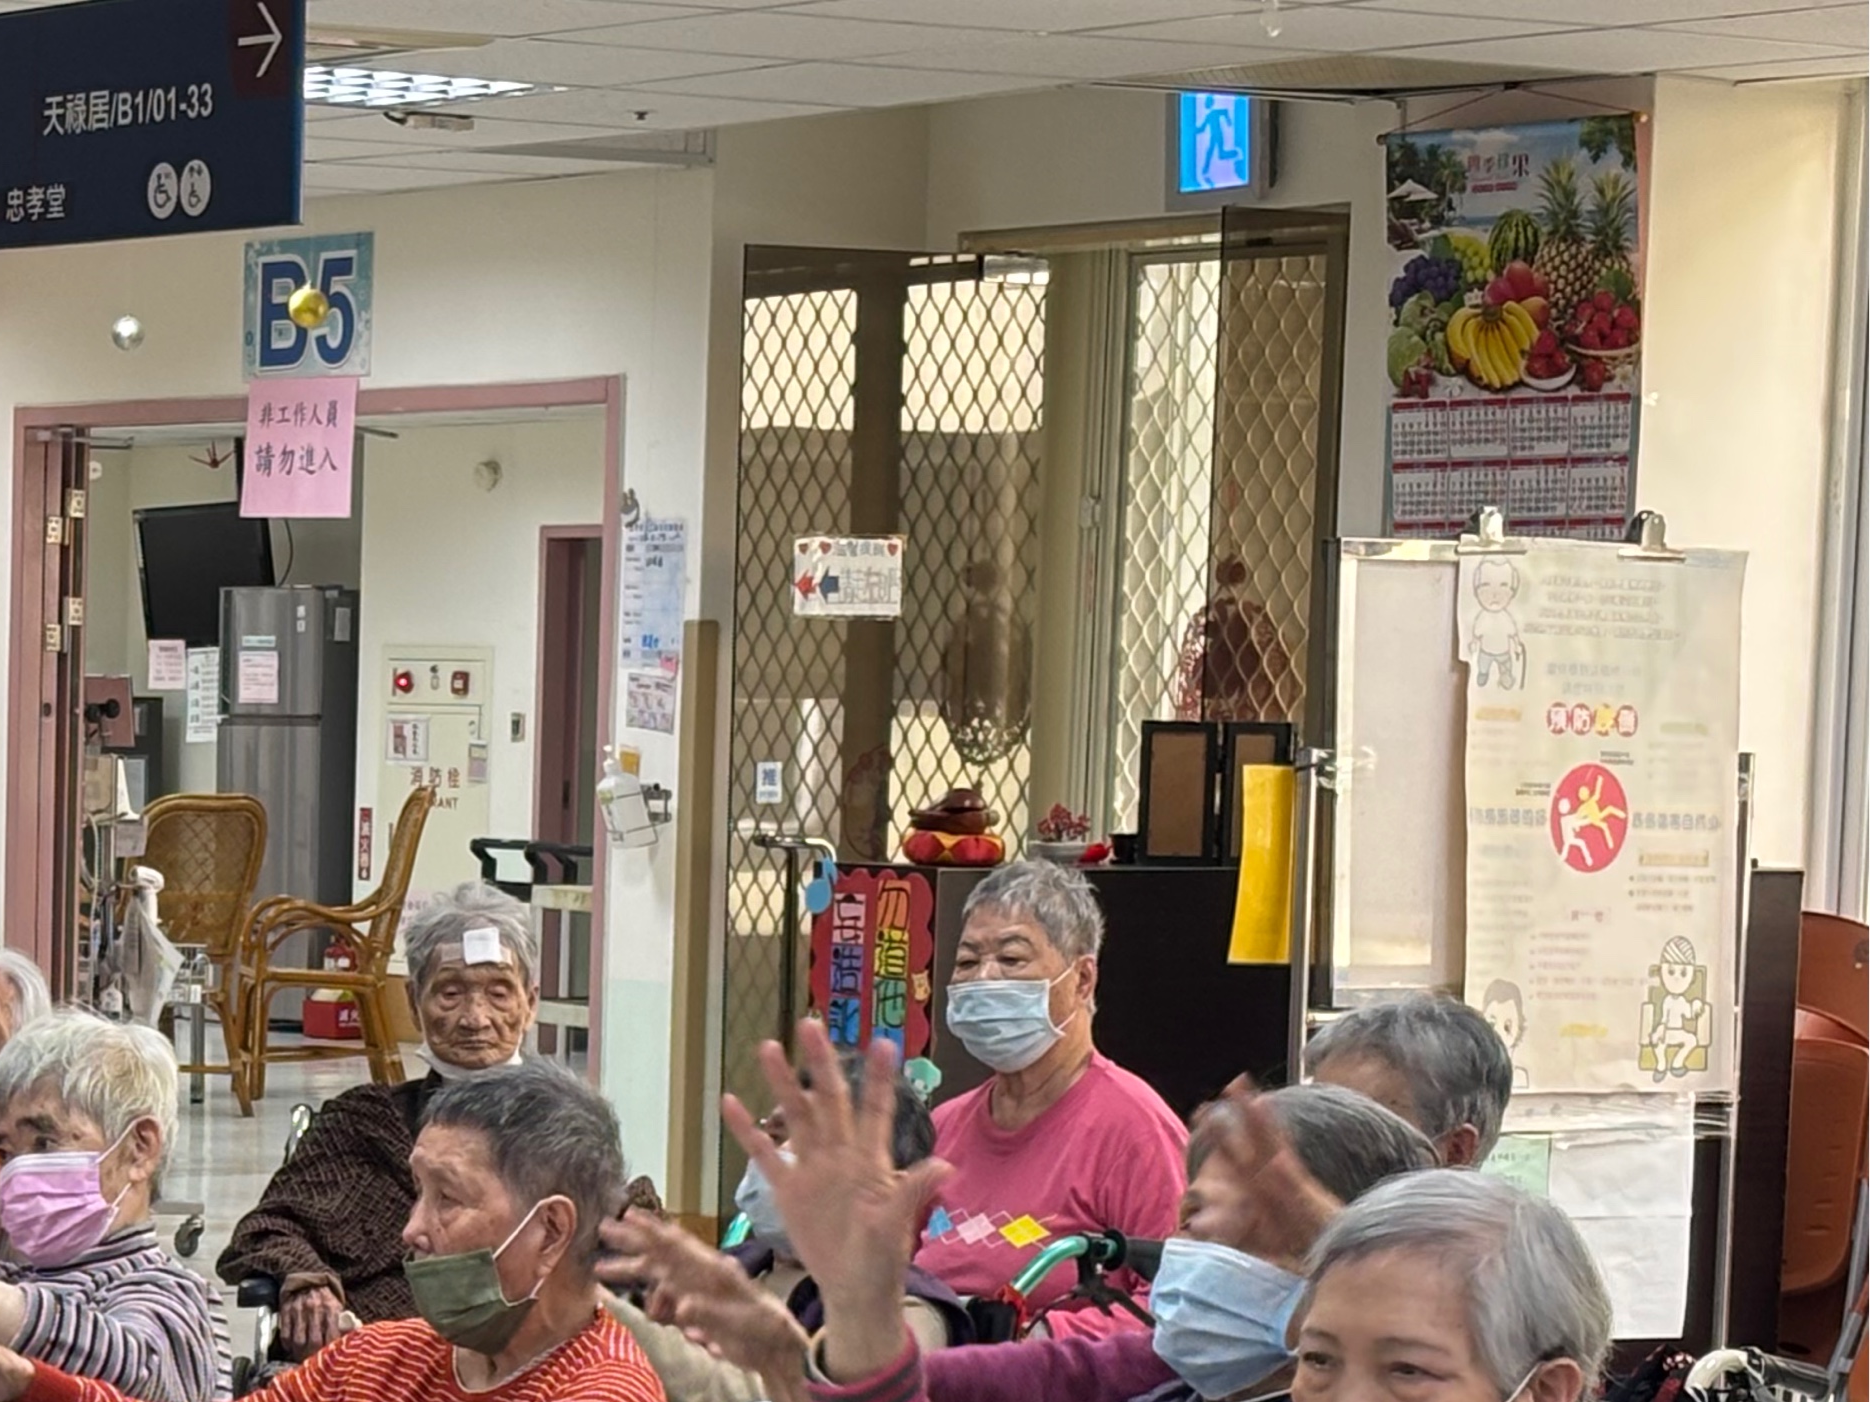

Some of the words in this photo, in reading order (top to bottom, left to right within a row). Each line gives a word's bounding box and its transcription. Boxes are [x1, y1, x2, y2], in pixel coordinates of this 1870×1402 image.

[5, 183, 66, 222] 忠孝堂
[258, 252, 356, 371] B5
[258, 400, 339, 429] 非工作人員
[254, 442, 338, 478] 請勿進入
